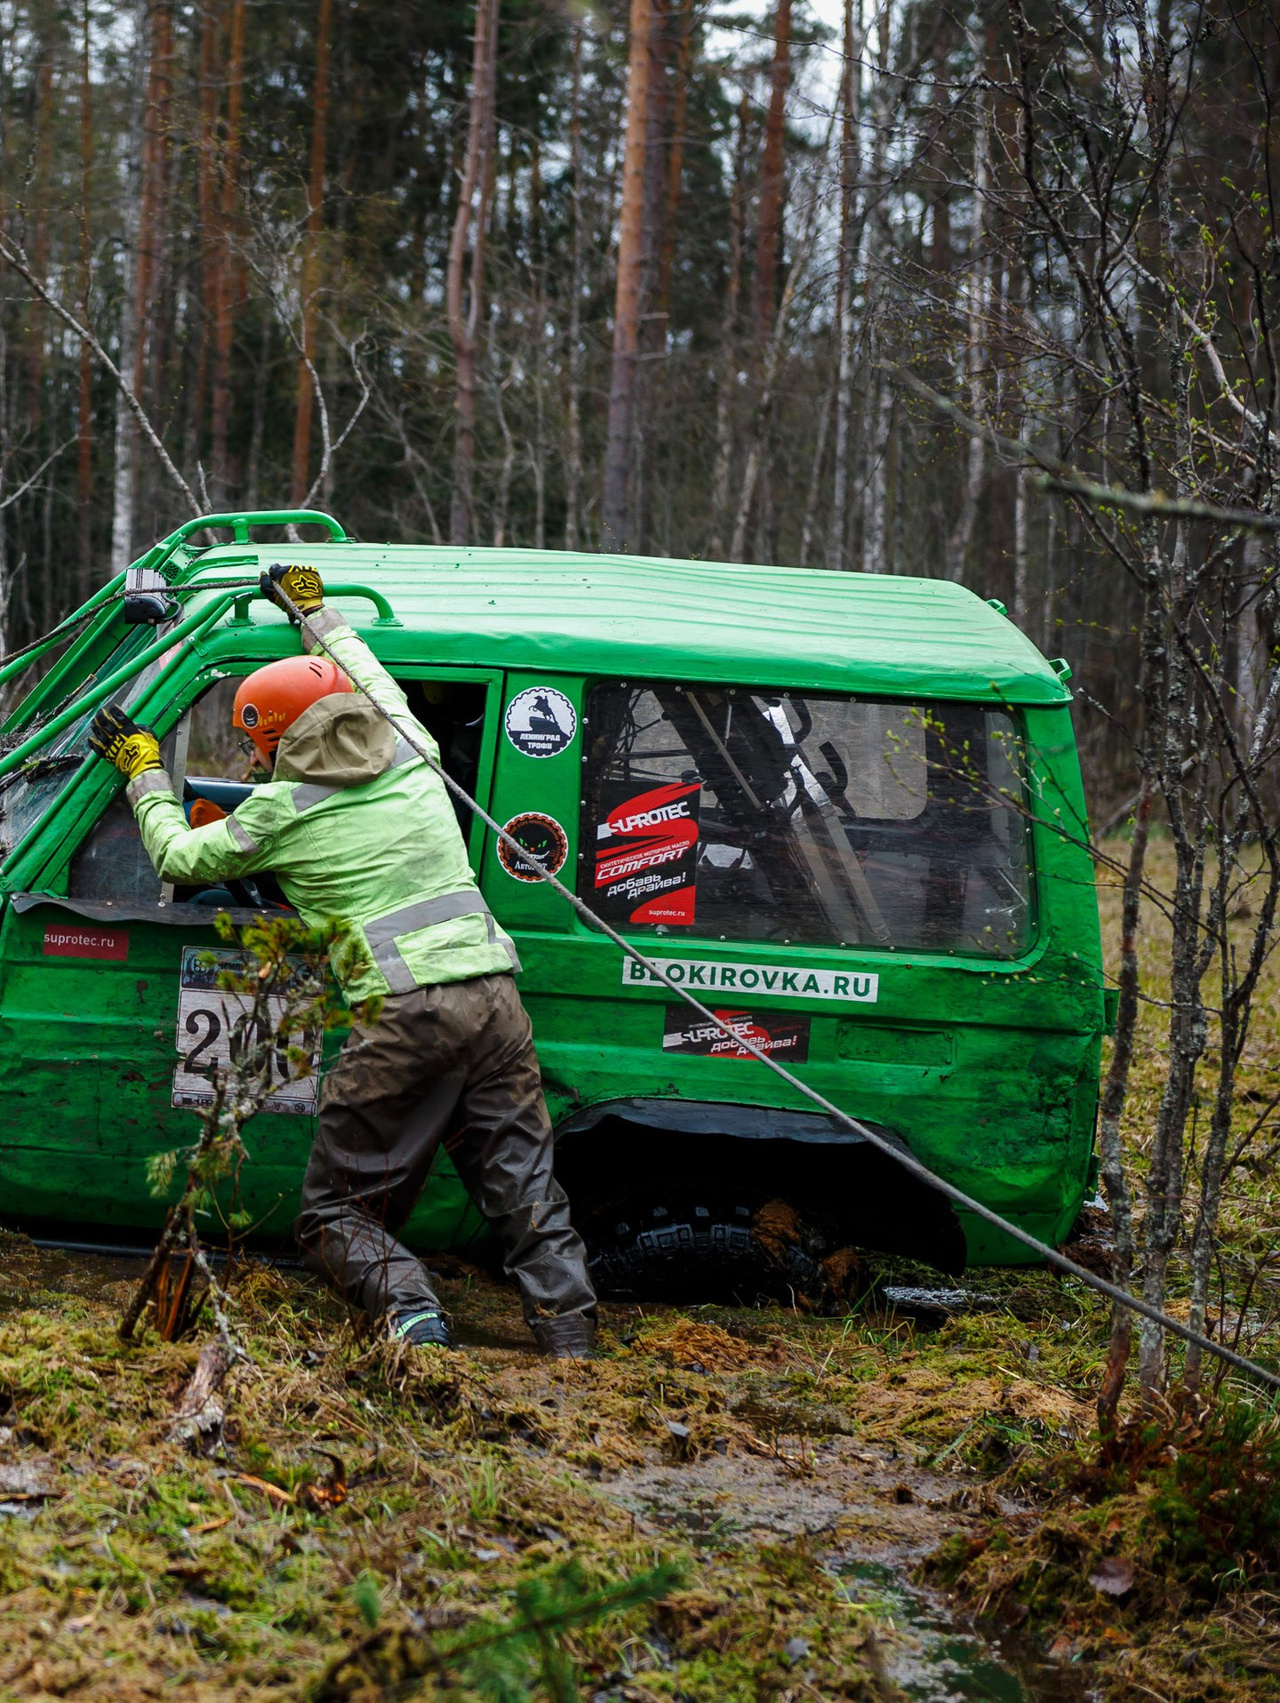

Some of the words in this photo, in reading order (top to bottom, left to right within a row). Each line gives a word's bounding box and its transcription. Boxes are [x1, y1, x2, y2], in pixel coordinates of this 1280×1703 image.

[520, 733, 560, 741] ЛЕНИНГРАД
[597, 801, 690, 840] SUPROTEC
[597, 847, 688, 880] COMFORT
[607, 874, 661, 897] добавь
[627, 872, 686, 899] драйва!
[43, 933, 115, 948] suprotec.ru
